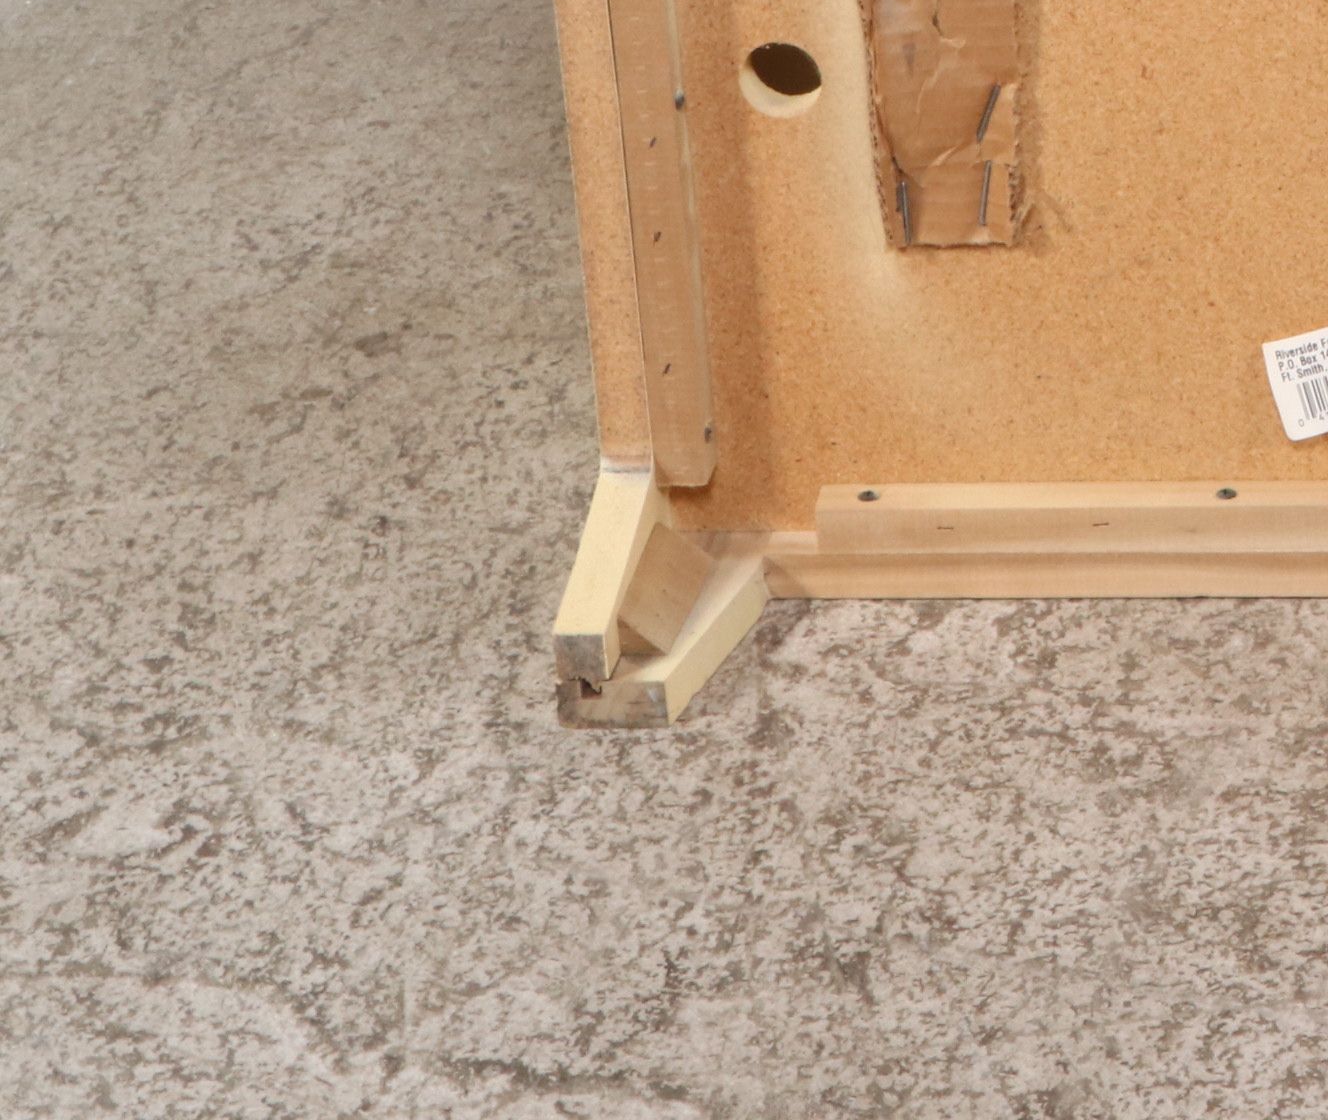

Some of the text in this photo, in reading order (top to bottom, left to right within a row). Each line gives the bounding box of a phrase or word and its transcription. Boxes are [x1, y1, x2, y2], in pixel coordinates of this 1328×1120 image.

[1275, 342, 1318, 360] Riverside
[1278, 359, 1297, 371] P.O.
[1300, 355, 1317, 366] Box
[1281, 371, 1294, 382] Ft.
[1297, 364, 1328, 378] Smith,
[1298, 418, 1305, 427] 0
